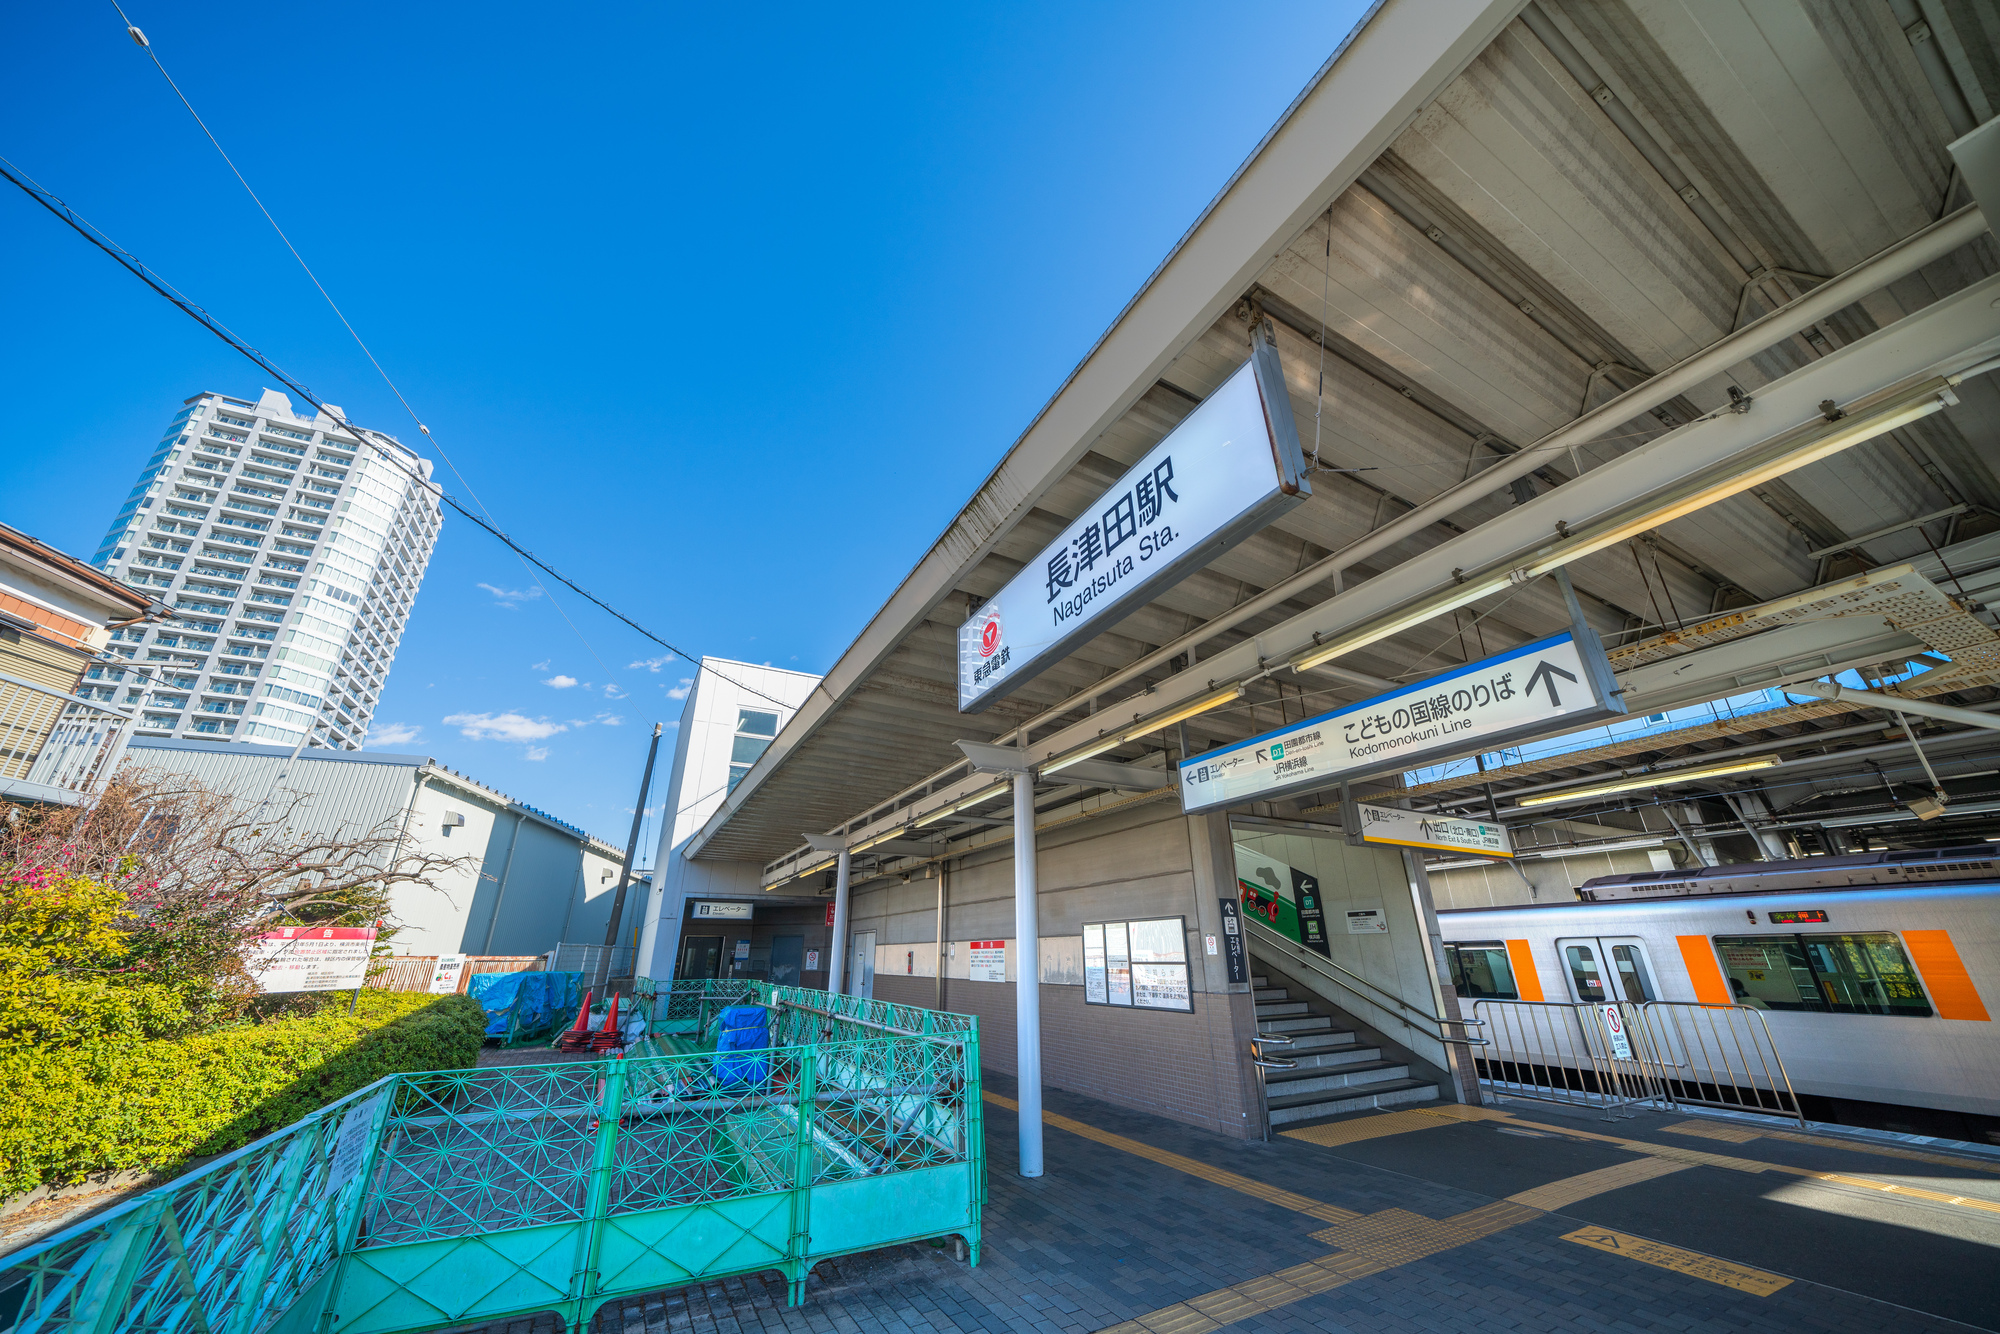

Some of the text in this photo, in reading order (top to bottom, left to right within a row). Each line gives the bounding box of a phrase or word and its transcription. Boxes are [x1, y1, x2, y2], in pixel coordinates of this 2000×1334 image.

[1046, 455, 1178, 604] 長津田駅
[1053, 555, 1134, 626] Nagatsuta
[1139, 525, 1179, 561] Sta.
[974, 645, 1011, 685] 東急電鉄
[1343, 672, 1516, 744] こどもの国線のりば
[1283, 731, 1321, 750] 田園都市線
[1314, 740, 1324, 748] Line
[1349, 717, 1472, 759] Kodomonokuni Line
[1272, 748, 1282, 757] DT
[1210, 758, 1244, 774] エレベーター
[1273, 756, 1308, 775] JR横浜線
[1281, 769, 1303, 779] Yokohama
[1433, 819, 1449, 833] 出口
[1230, 937, 1239, 979] エレベーター
